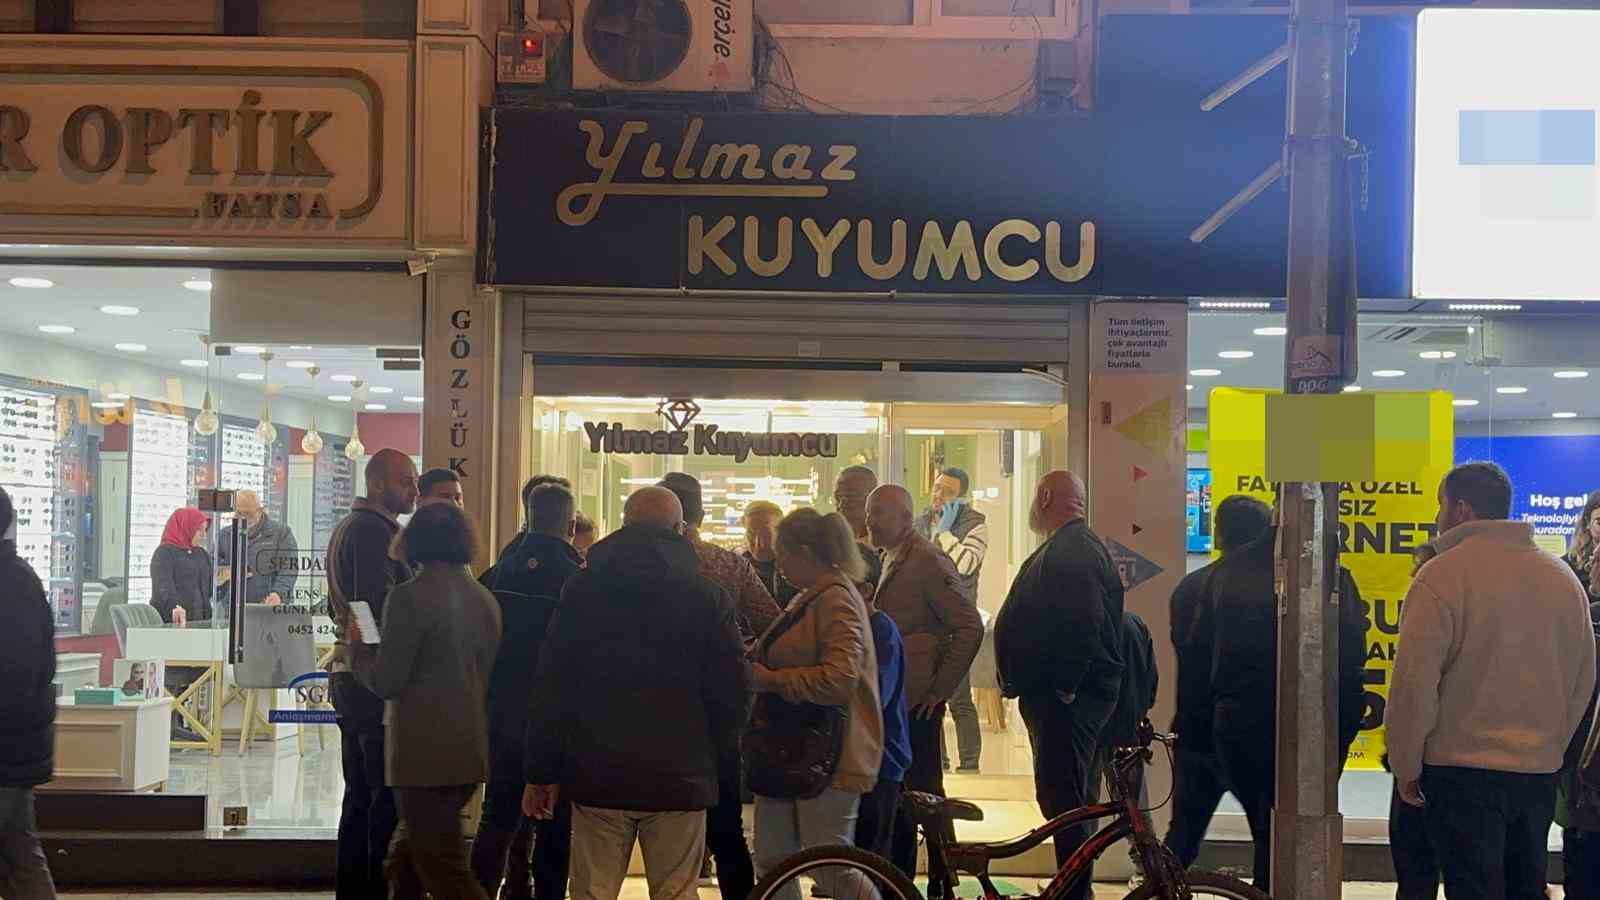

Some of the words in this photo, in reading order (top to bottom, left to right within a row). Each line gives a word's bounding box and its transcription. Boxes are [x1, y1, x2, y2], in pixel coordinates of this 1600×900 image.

[713, 0, 736, 58] arçel
[63, 90, 335, 178] OPTİK
[555, 116, 857, 227] Yılmaz
[206, 192, 334, 218] FATSA
[687, 215, 1096, 283] KUYUMCU
[449, 309, 471, 478] GÖZLÜK
[694, 423, 838, 463] Kuyumcu
[1530, 493, 1560, 510] Hoş
[1564, 493, 1588, 509] gel
[269, 557, 328, 571] SERDA
[288, 625, 313, 634] 0452
[296, 685, 330, 704] SG
